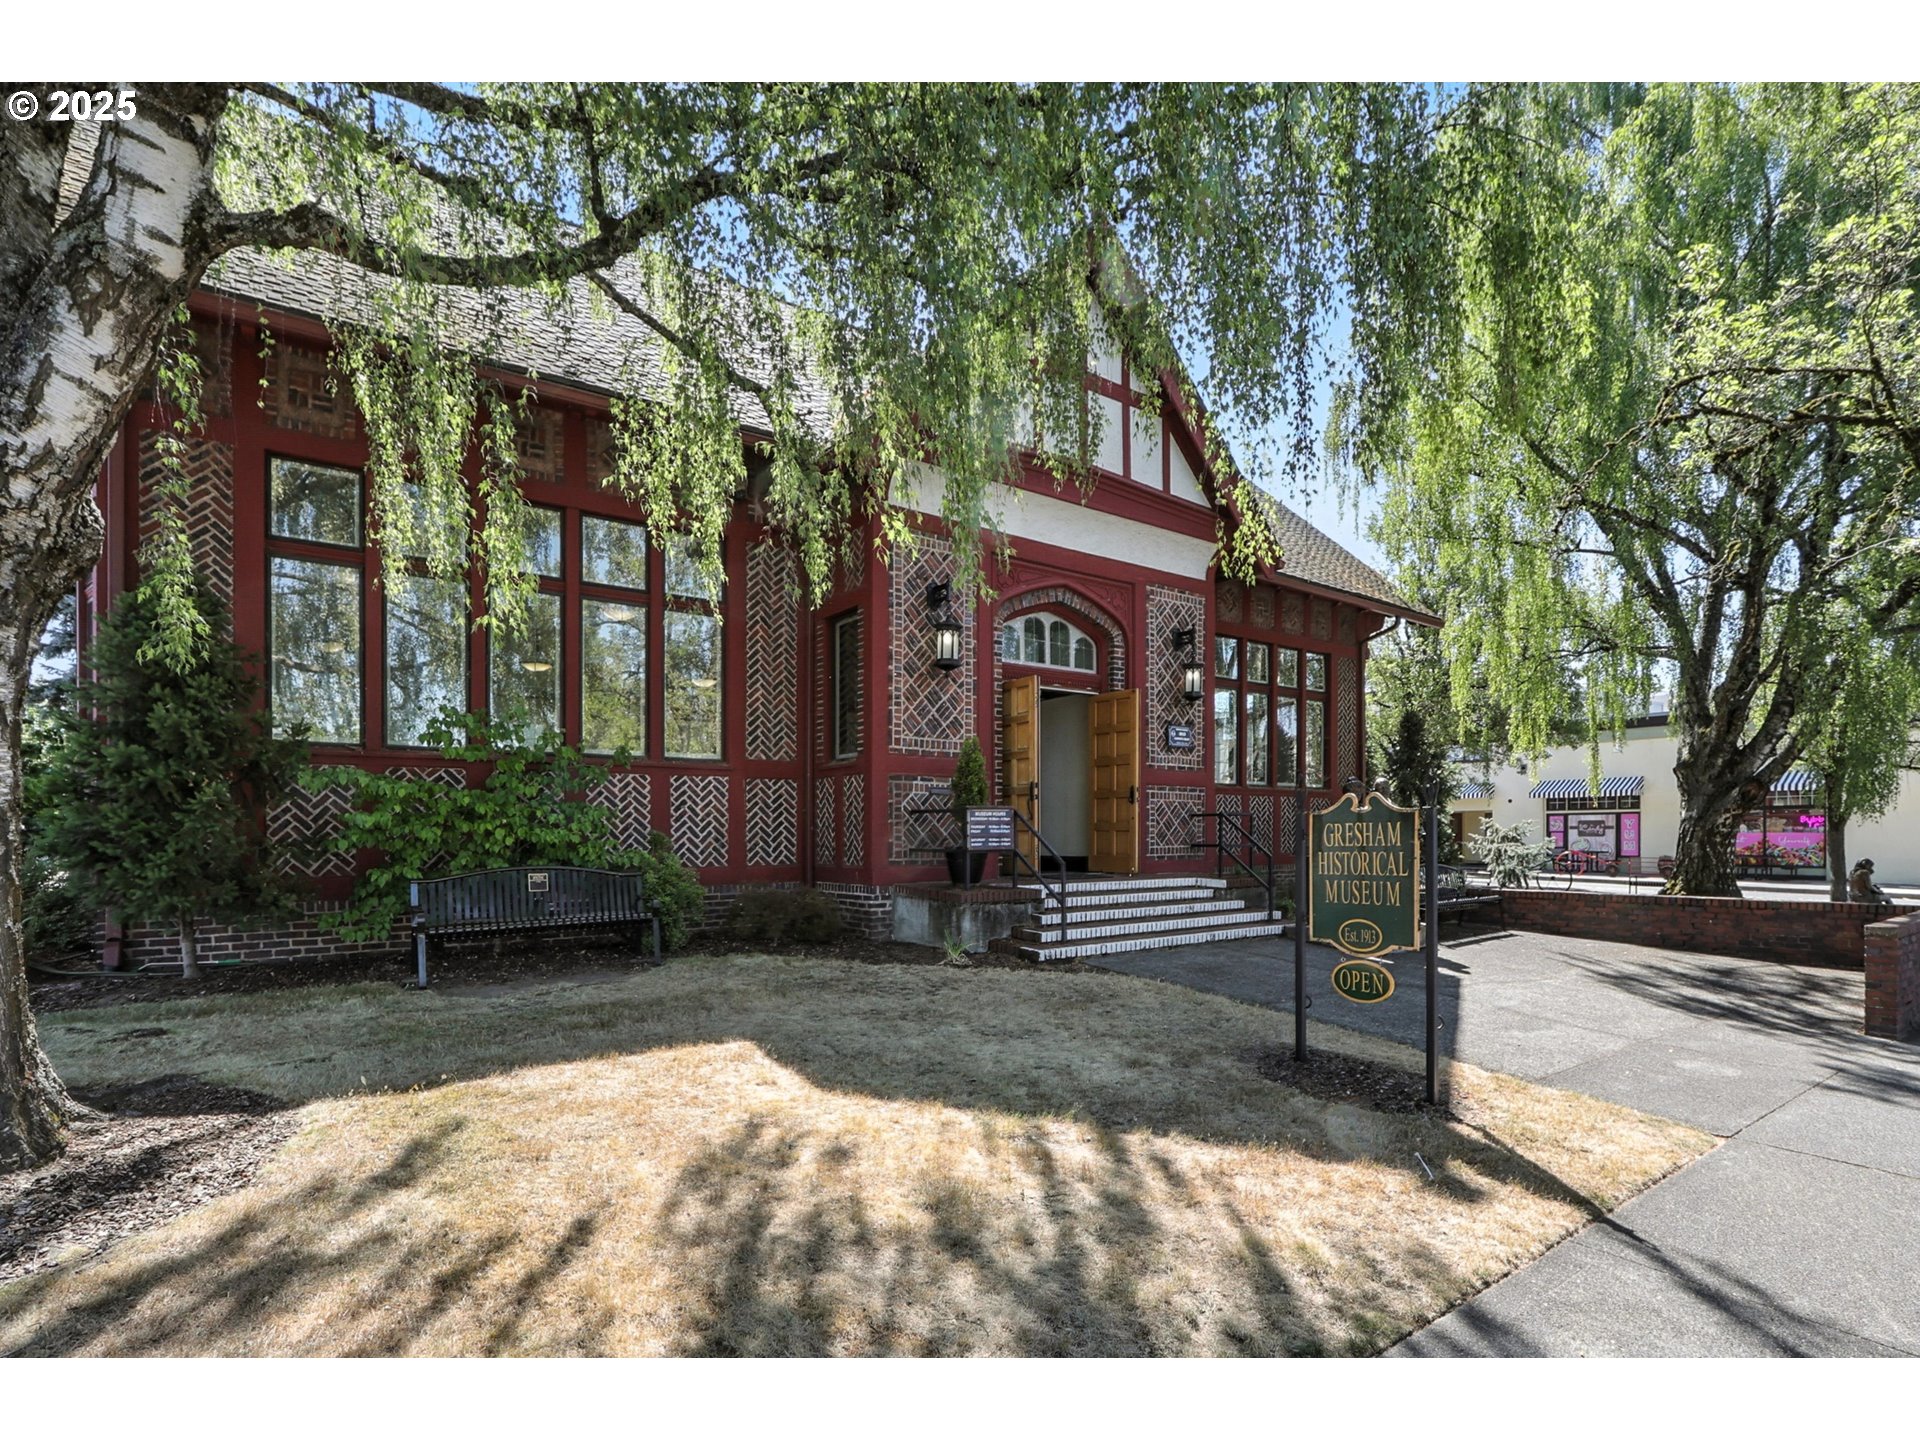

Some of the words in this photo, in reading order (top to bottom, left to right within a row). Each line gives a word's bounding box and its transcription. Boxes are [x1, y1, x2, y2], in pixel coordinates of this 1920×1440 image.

[1323, 821, 1402, 847] GRESHAM
[1318, 850, 1409, 877] HISTORICAL
[1325, 879, 1401, 907] MUSEUM
[1344, 927, 1359, 943] Est.
[1360, 929, 1377, 944] 1913
[1340, 969, 1384, 995] OPEN
